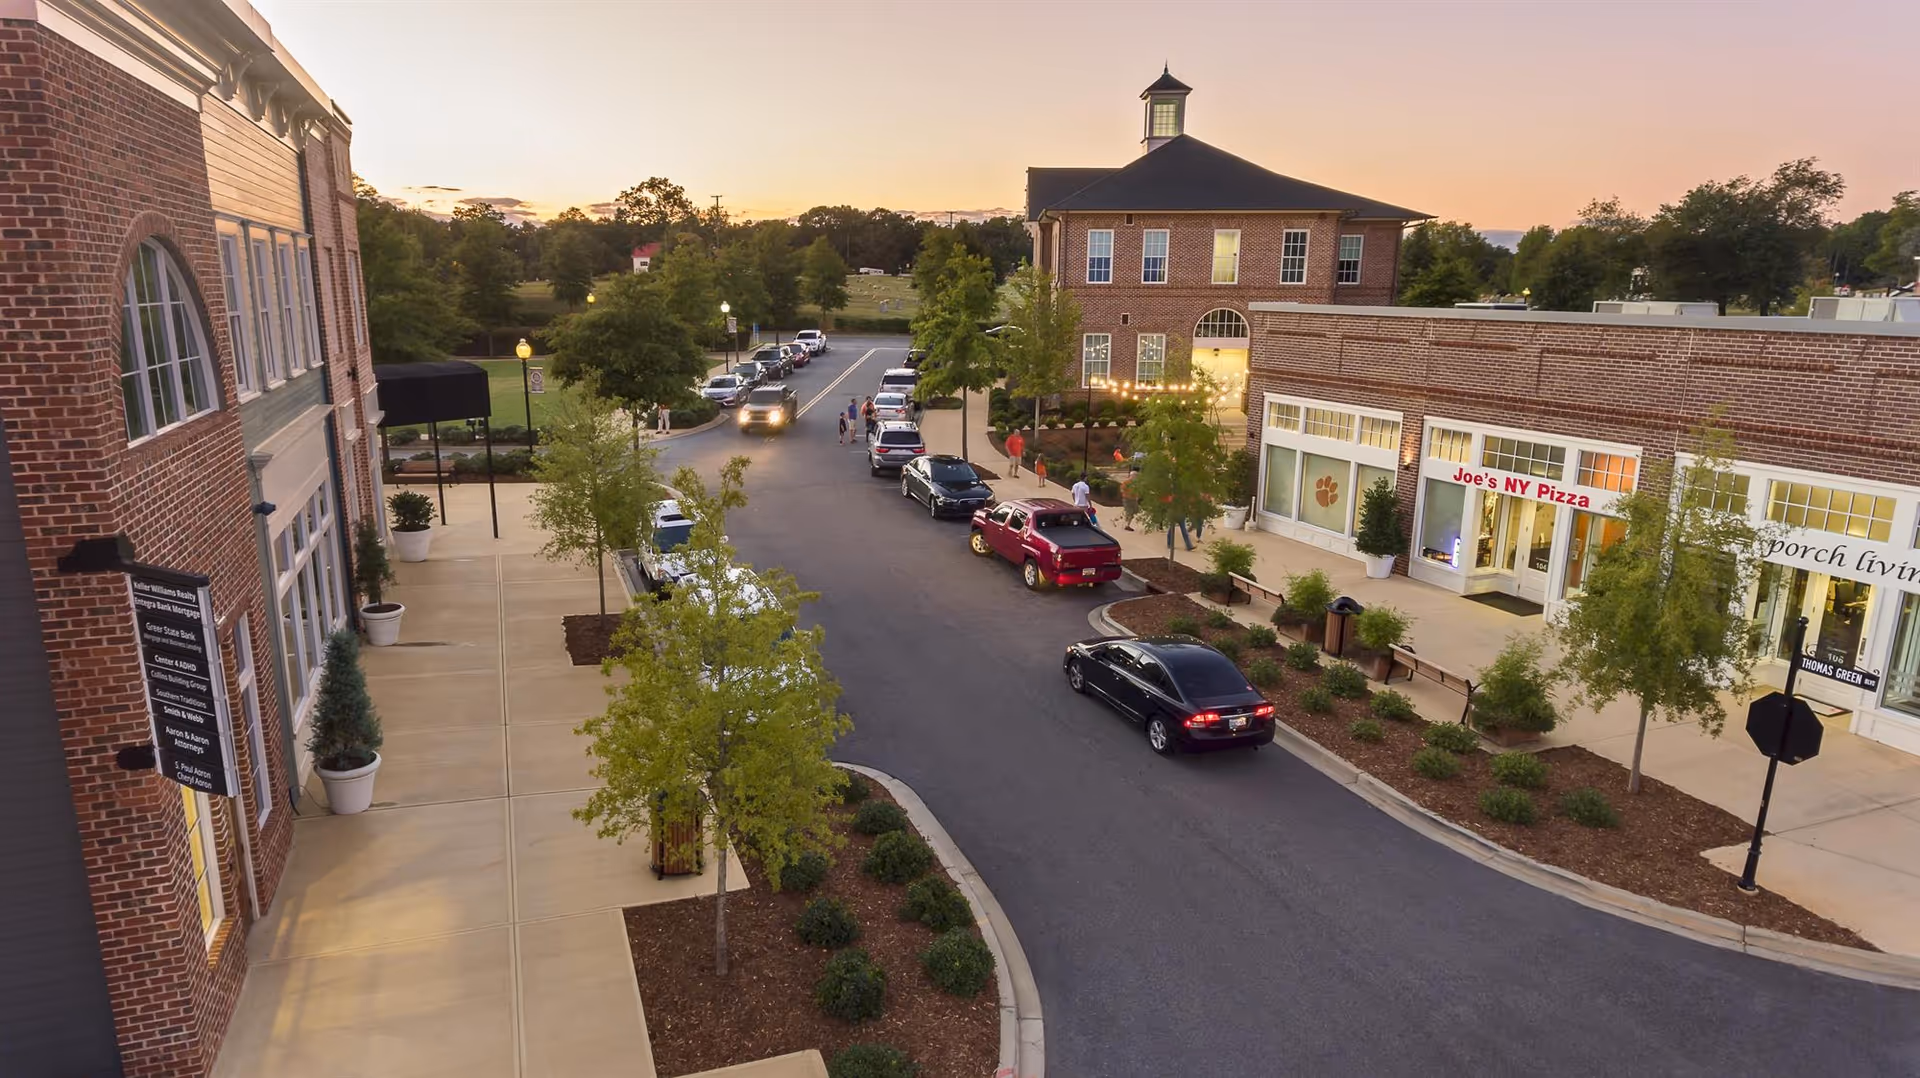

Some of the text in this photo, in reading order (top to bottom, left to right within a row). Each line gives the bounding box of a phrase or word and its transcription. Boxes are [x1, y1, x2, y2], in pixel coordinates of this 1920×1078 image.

[1453, 467, 1590, 508] Joe's NY Pizza
[1764, 538, 1848, 568] porch
[133, 582, 196, 603] Keller Williams Realty
[134, 597, 200, 619] Entegra Bank Mortgage
[145, 622, 196, 642] Greer State Bank
[154, 655, 174, 666] Center
[179, 661, 197, 672] ADHD
[1802, 657, 1876, 687] THOMAS GREEN BLVD
[150, 670, 207, 692] Collins Building Group
[155, 688, 207, 709] Southern Traditions
[163, 705, 204, 724] Smith & Webb
[165, 726, 210, 746] Aaron & Aaron
[174, 738, 204, 755] Attorneys
[174, 760, 212, 780] S. Paul Aaron
[176, 772, 213, 790] Cheryl Aaron
